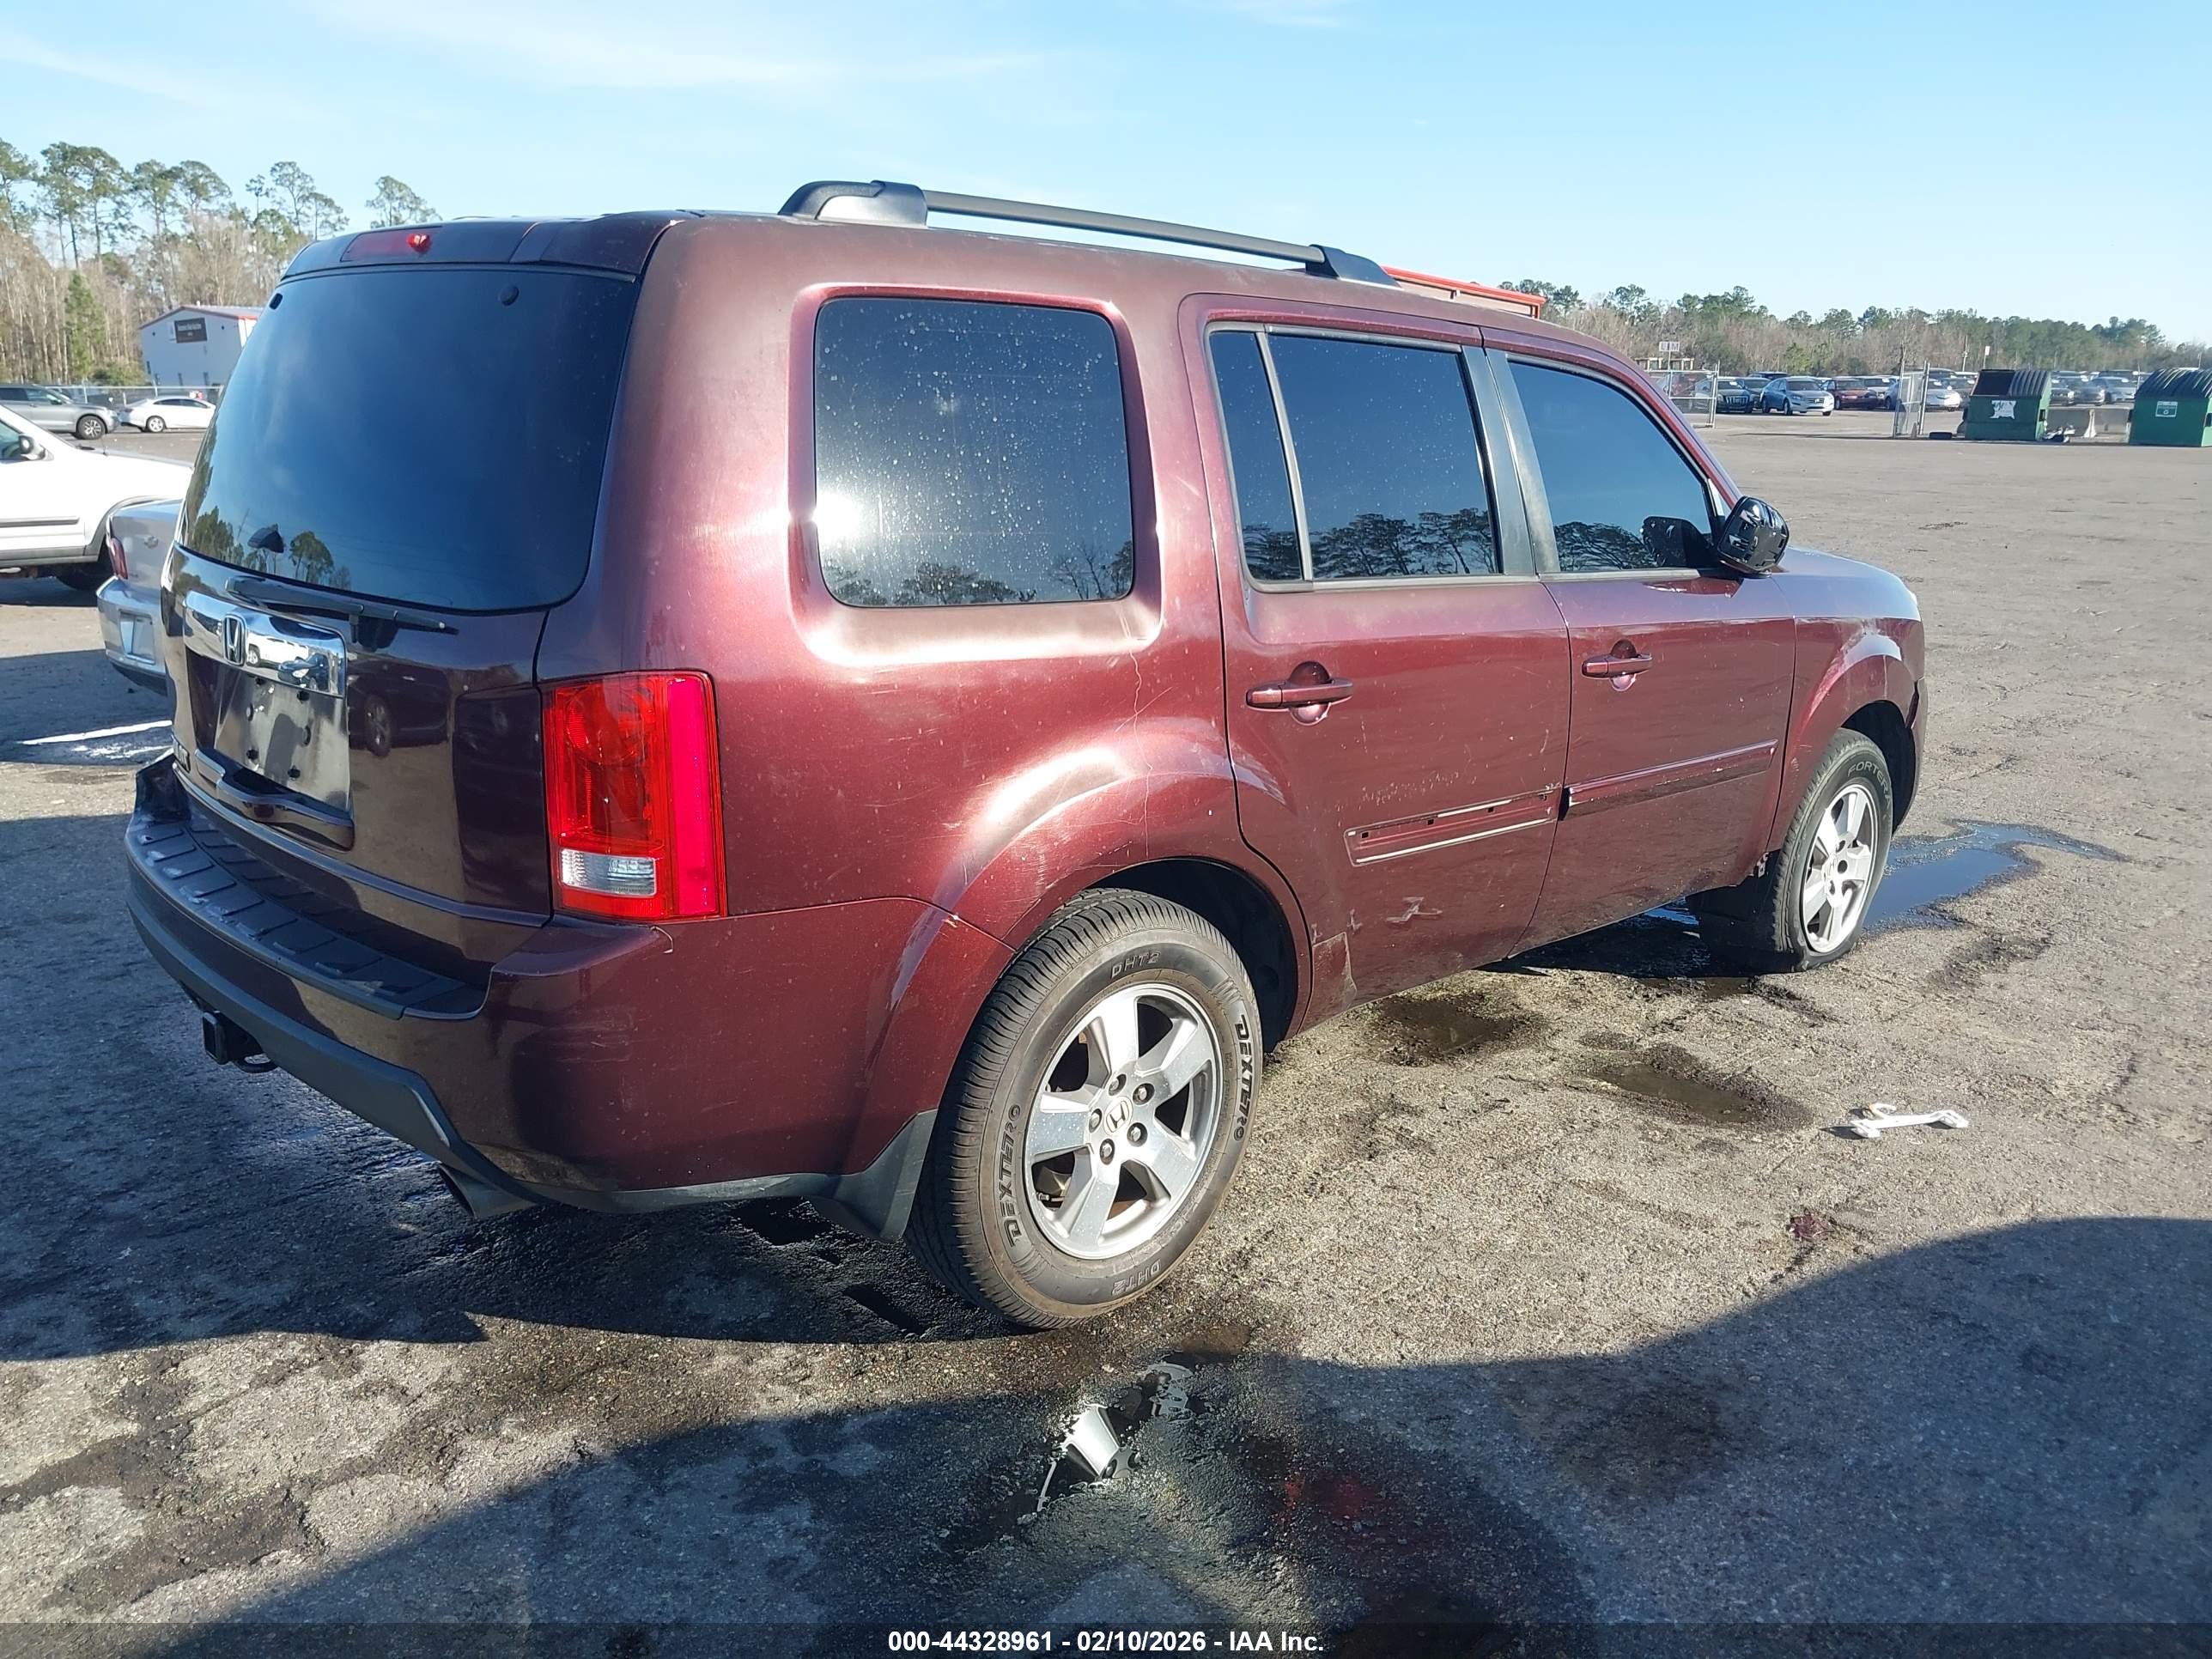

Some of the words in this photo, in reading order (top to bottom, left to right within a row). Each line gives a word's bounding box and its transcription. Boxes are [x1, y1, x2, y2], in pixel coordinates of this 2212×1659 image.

[1847, 761, 1891, 810] FORTERA
[1111, 951, 1161, 979] DHT2
[1235, 1014, 1253, 1141] DEXTERO
[999, 1104, 1022, 1247] DEXTERO
[1112, 1258, 1161, 1295] DHT2
